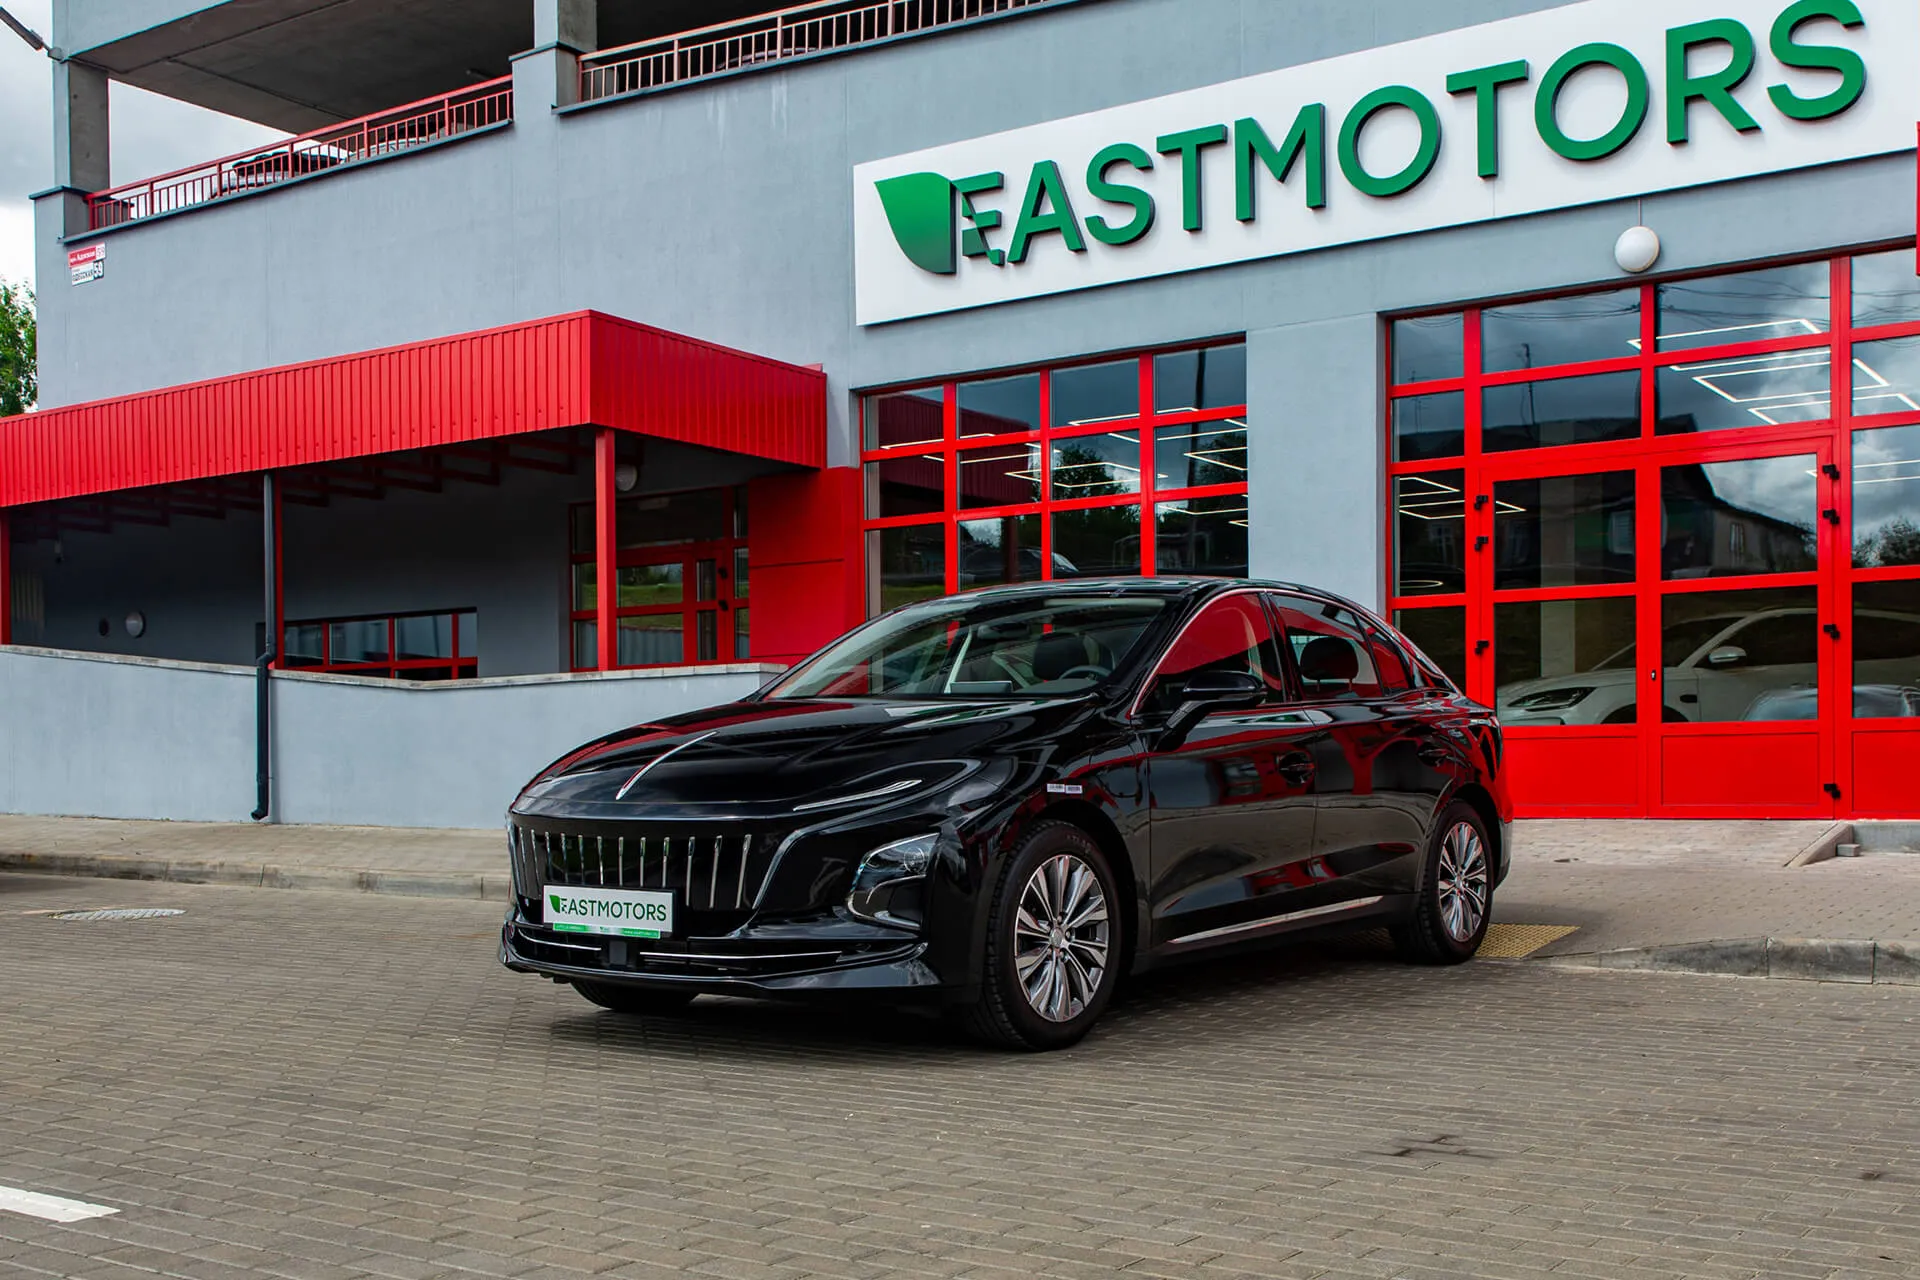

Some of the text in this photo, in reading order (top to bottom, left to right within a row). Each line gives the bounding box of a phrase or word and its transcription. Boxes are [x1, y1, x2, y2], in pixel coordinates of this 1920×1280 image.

[952, 0, 1867, 265] EASTMOTORS
[94, 261, 103, 277] 59
[560, 898, 667, 921] EASTMOTORS
